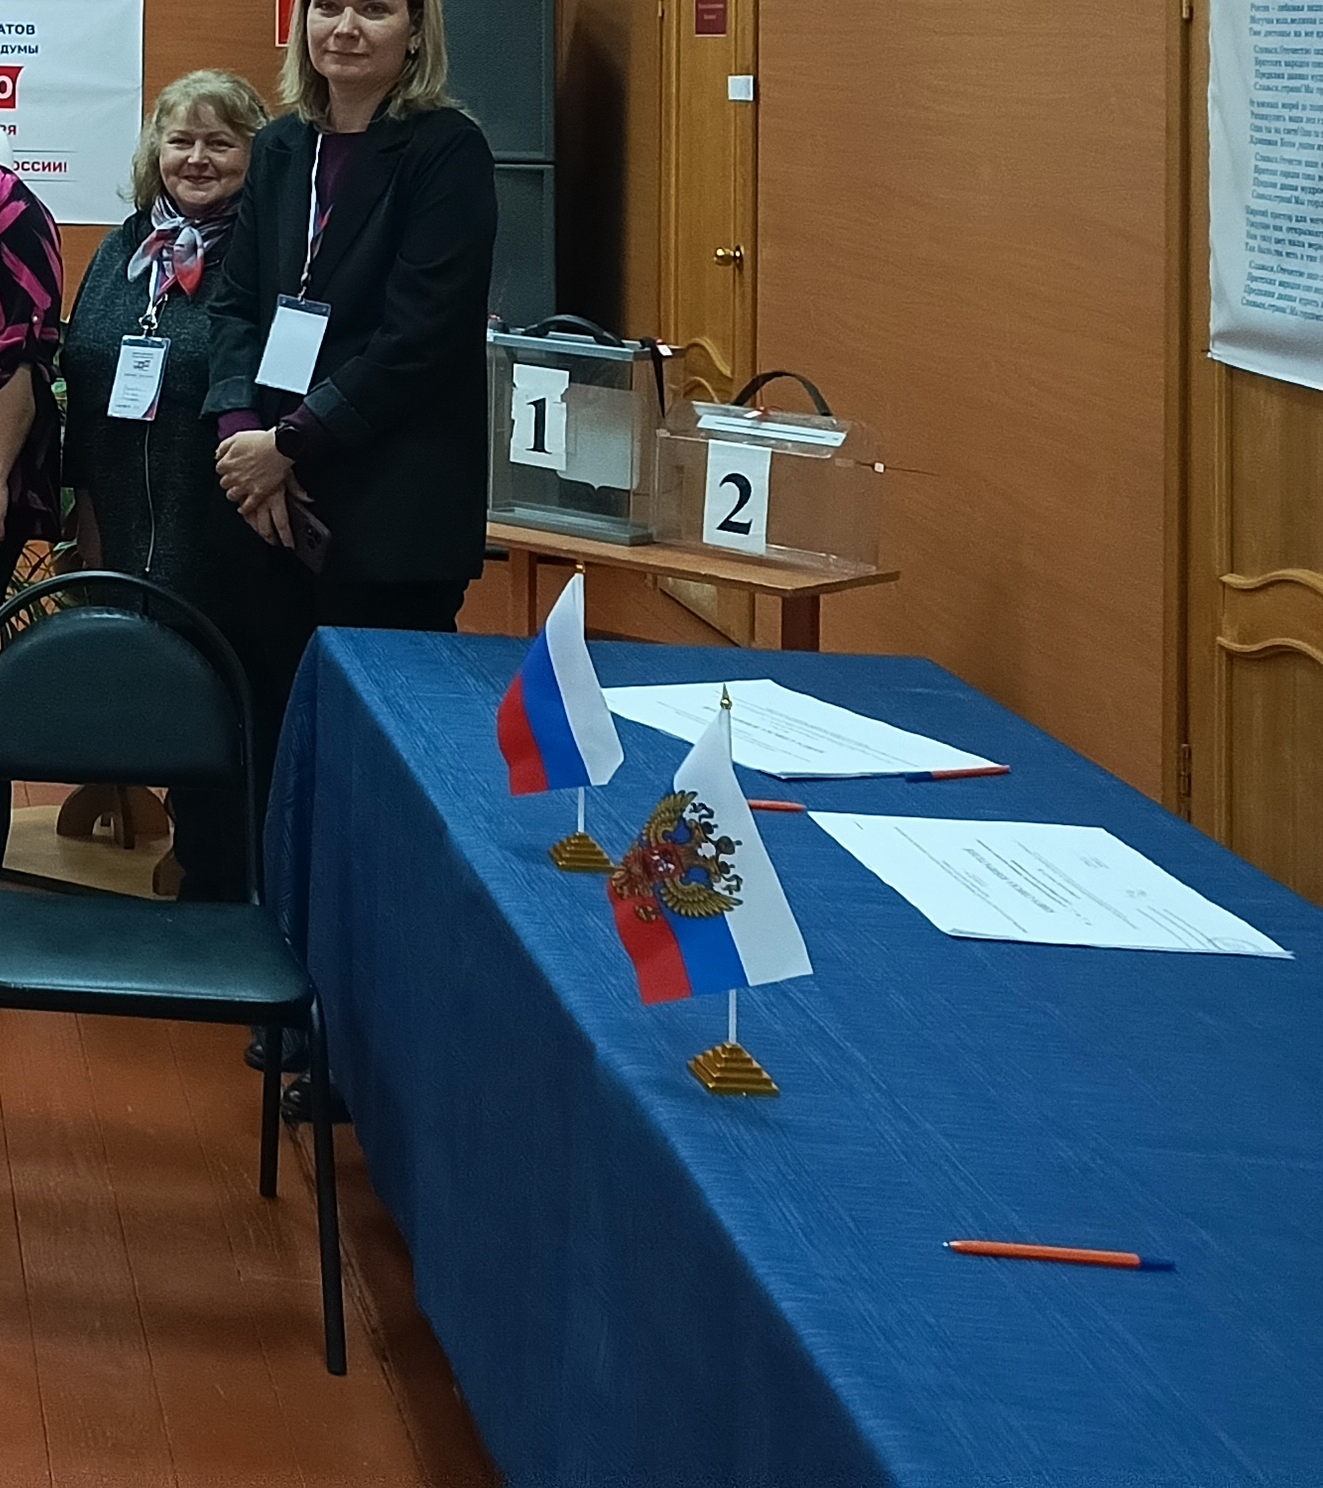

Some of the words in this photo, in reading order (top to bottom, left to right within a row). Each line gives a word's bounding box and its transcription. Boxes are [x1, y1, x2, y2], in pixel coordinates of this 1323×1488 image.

[0, 44, 39, 54] ДУМЫ
[525, 397, 553, 455] 1
[715, 472, 754, 536] 2
